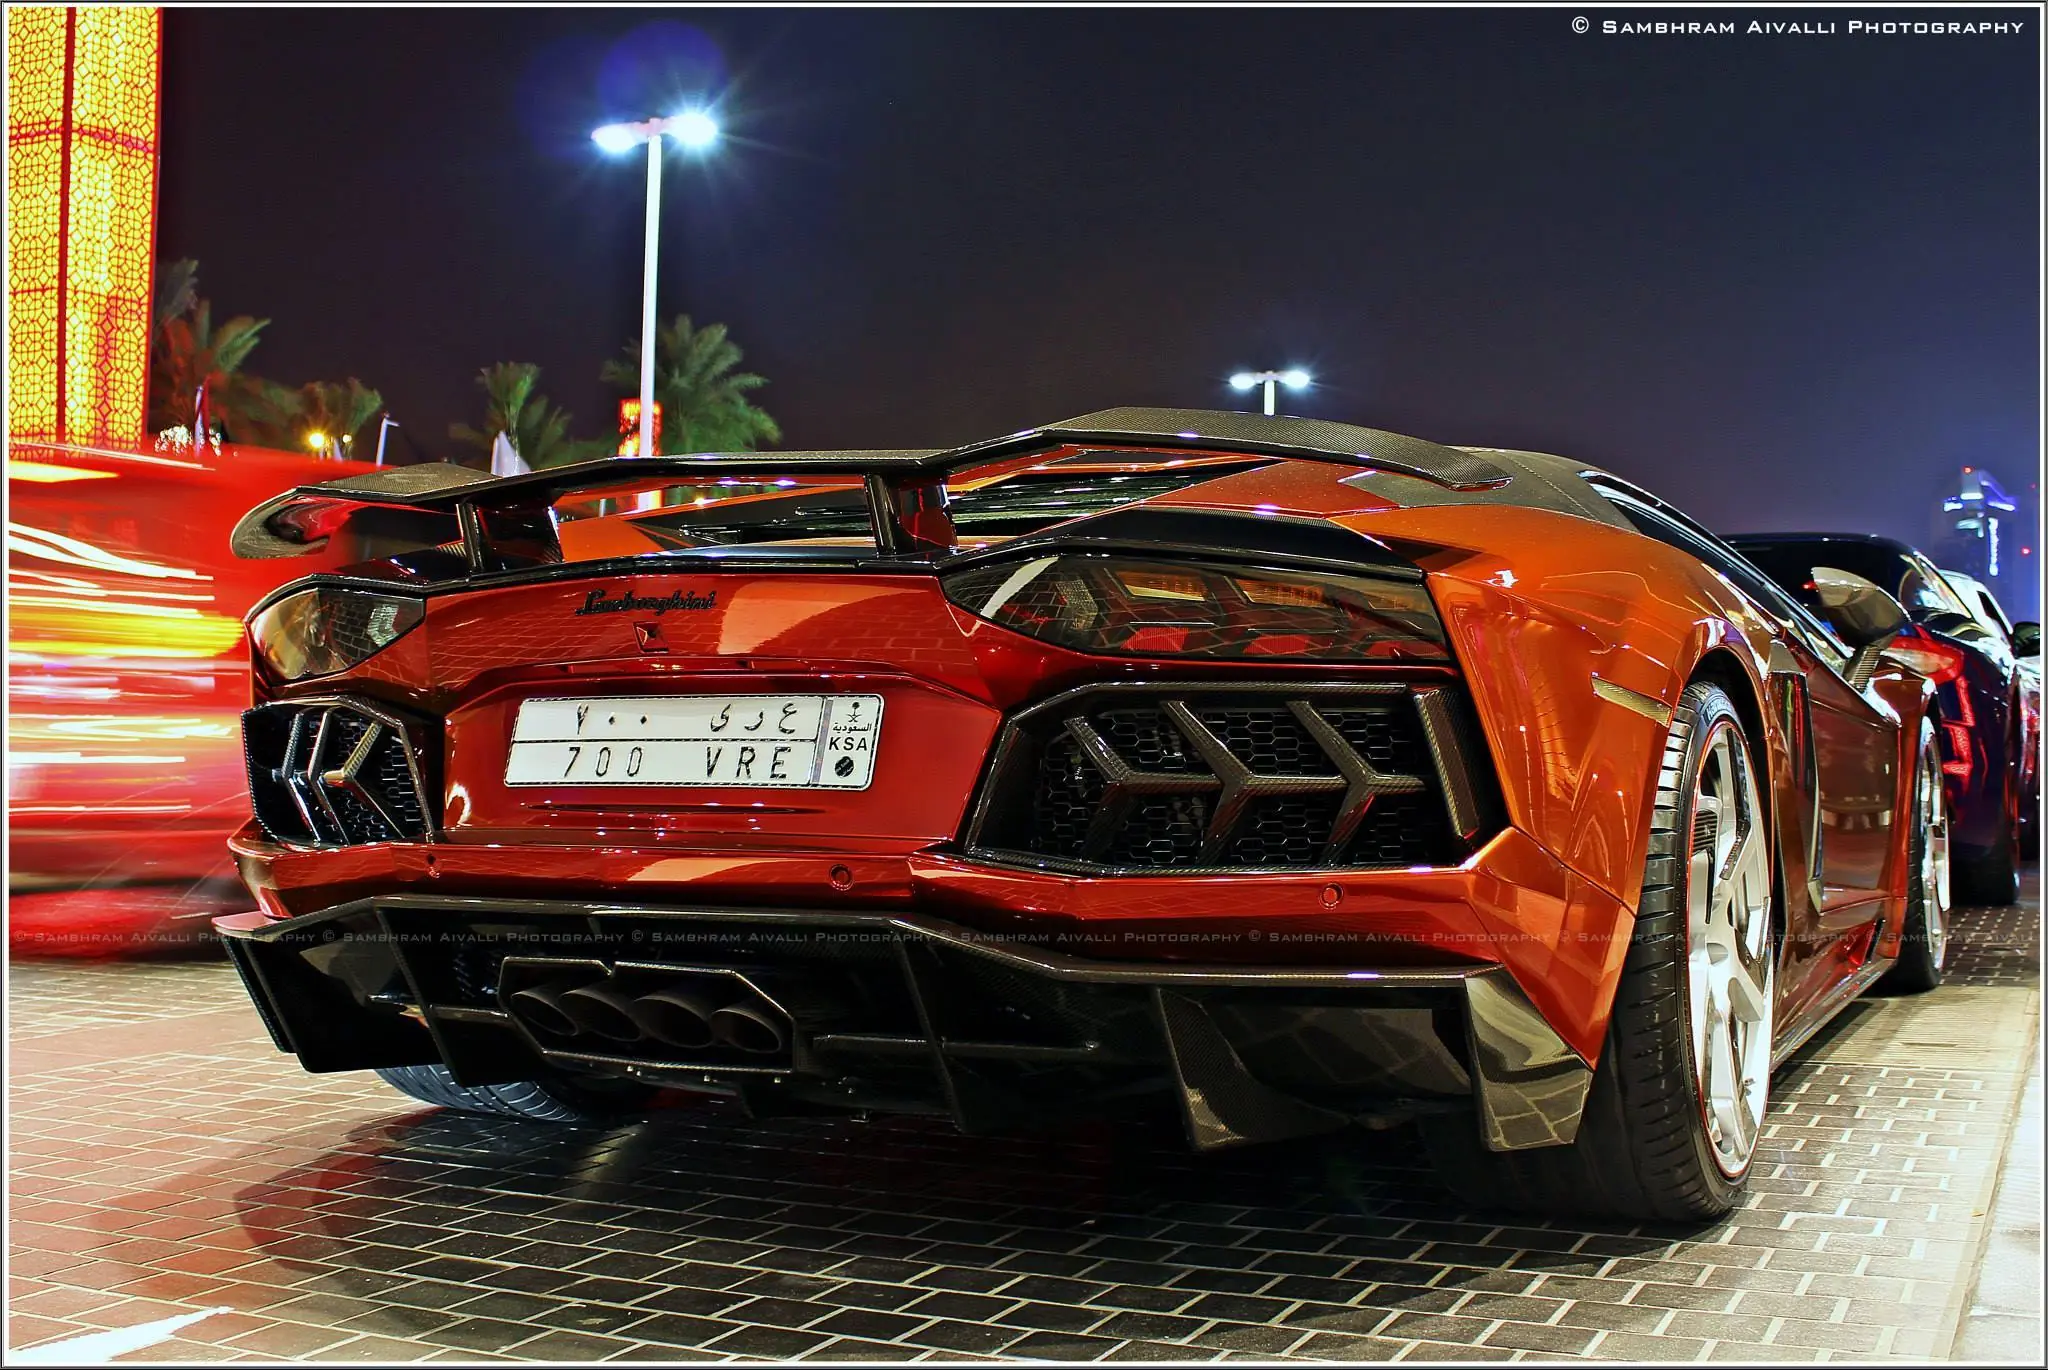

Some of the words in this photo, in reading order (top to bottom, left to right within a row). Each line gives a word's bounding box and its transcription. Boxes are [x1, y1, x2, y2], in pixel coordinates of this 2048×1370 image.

[575, 589, 717, 616] Lamborghini
[832, 722, 872, 734] السعودية
[828, 736, 868, 751] KSA
[564, 746, 643, 778] 700
[706, 746, 792, 779] VRE
